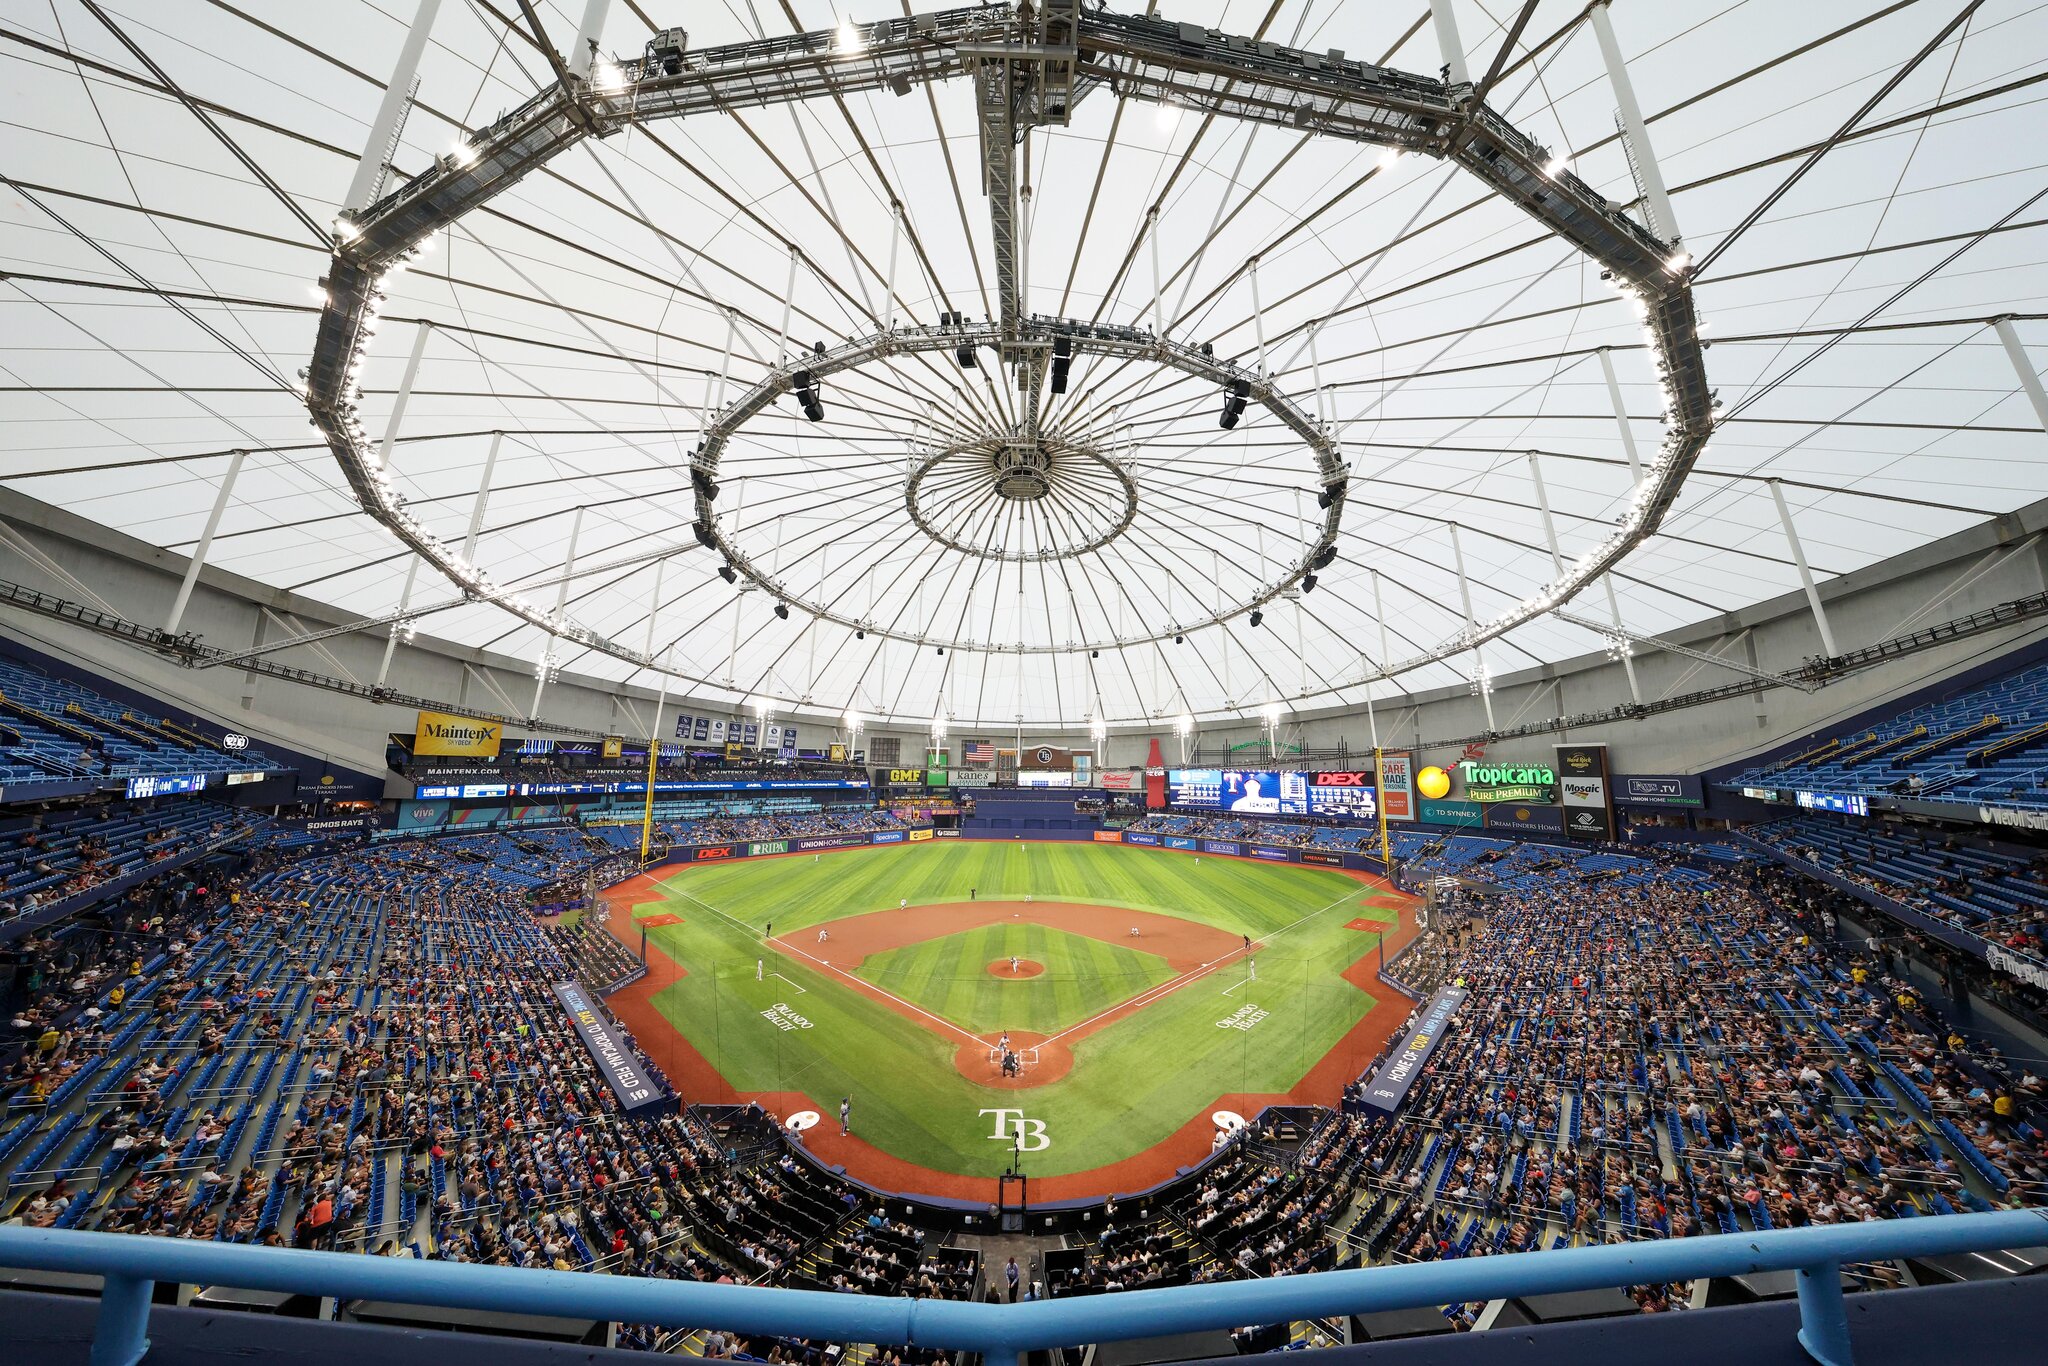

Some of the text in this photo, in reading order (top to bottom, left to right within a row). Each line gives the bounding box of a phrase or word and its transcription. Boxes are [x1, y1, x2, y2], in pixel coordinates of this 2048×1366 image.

[424, 724, 496, 746] MaintenX
[890, 770, 921, 782] GMF
[1317, 773, 1366, 785] DEX
[1460, 762, 1554, 786] Tropicana
[1470, 788, 1542, 799] PURE PREMIUM
[1565, 784, 1600, 793] Mosaic
[413, 809, 434, 818] VIVA
[307, 821, 340, 829] SOMOS
[698, 848, 731, 859] DEX
[761, 843, 784, 853] RIPA
[760, 1008, 799, 1031] HEALTH
[772, 1003, 814, 1028] ORLANDO
[1216, 1004, 1258, 1028] ORLANDO
[1233, 1009, 1270, 1031] HEALTH
[564, 990, 640, 1088] WELCOME BACK TO TROPICANA FIELD
[1387, 998, 1454, 1083] HOME OF YOUR TAMPA BAY RAYS
[978, 1108, 1051, 1152] TB
